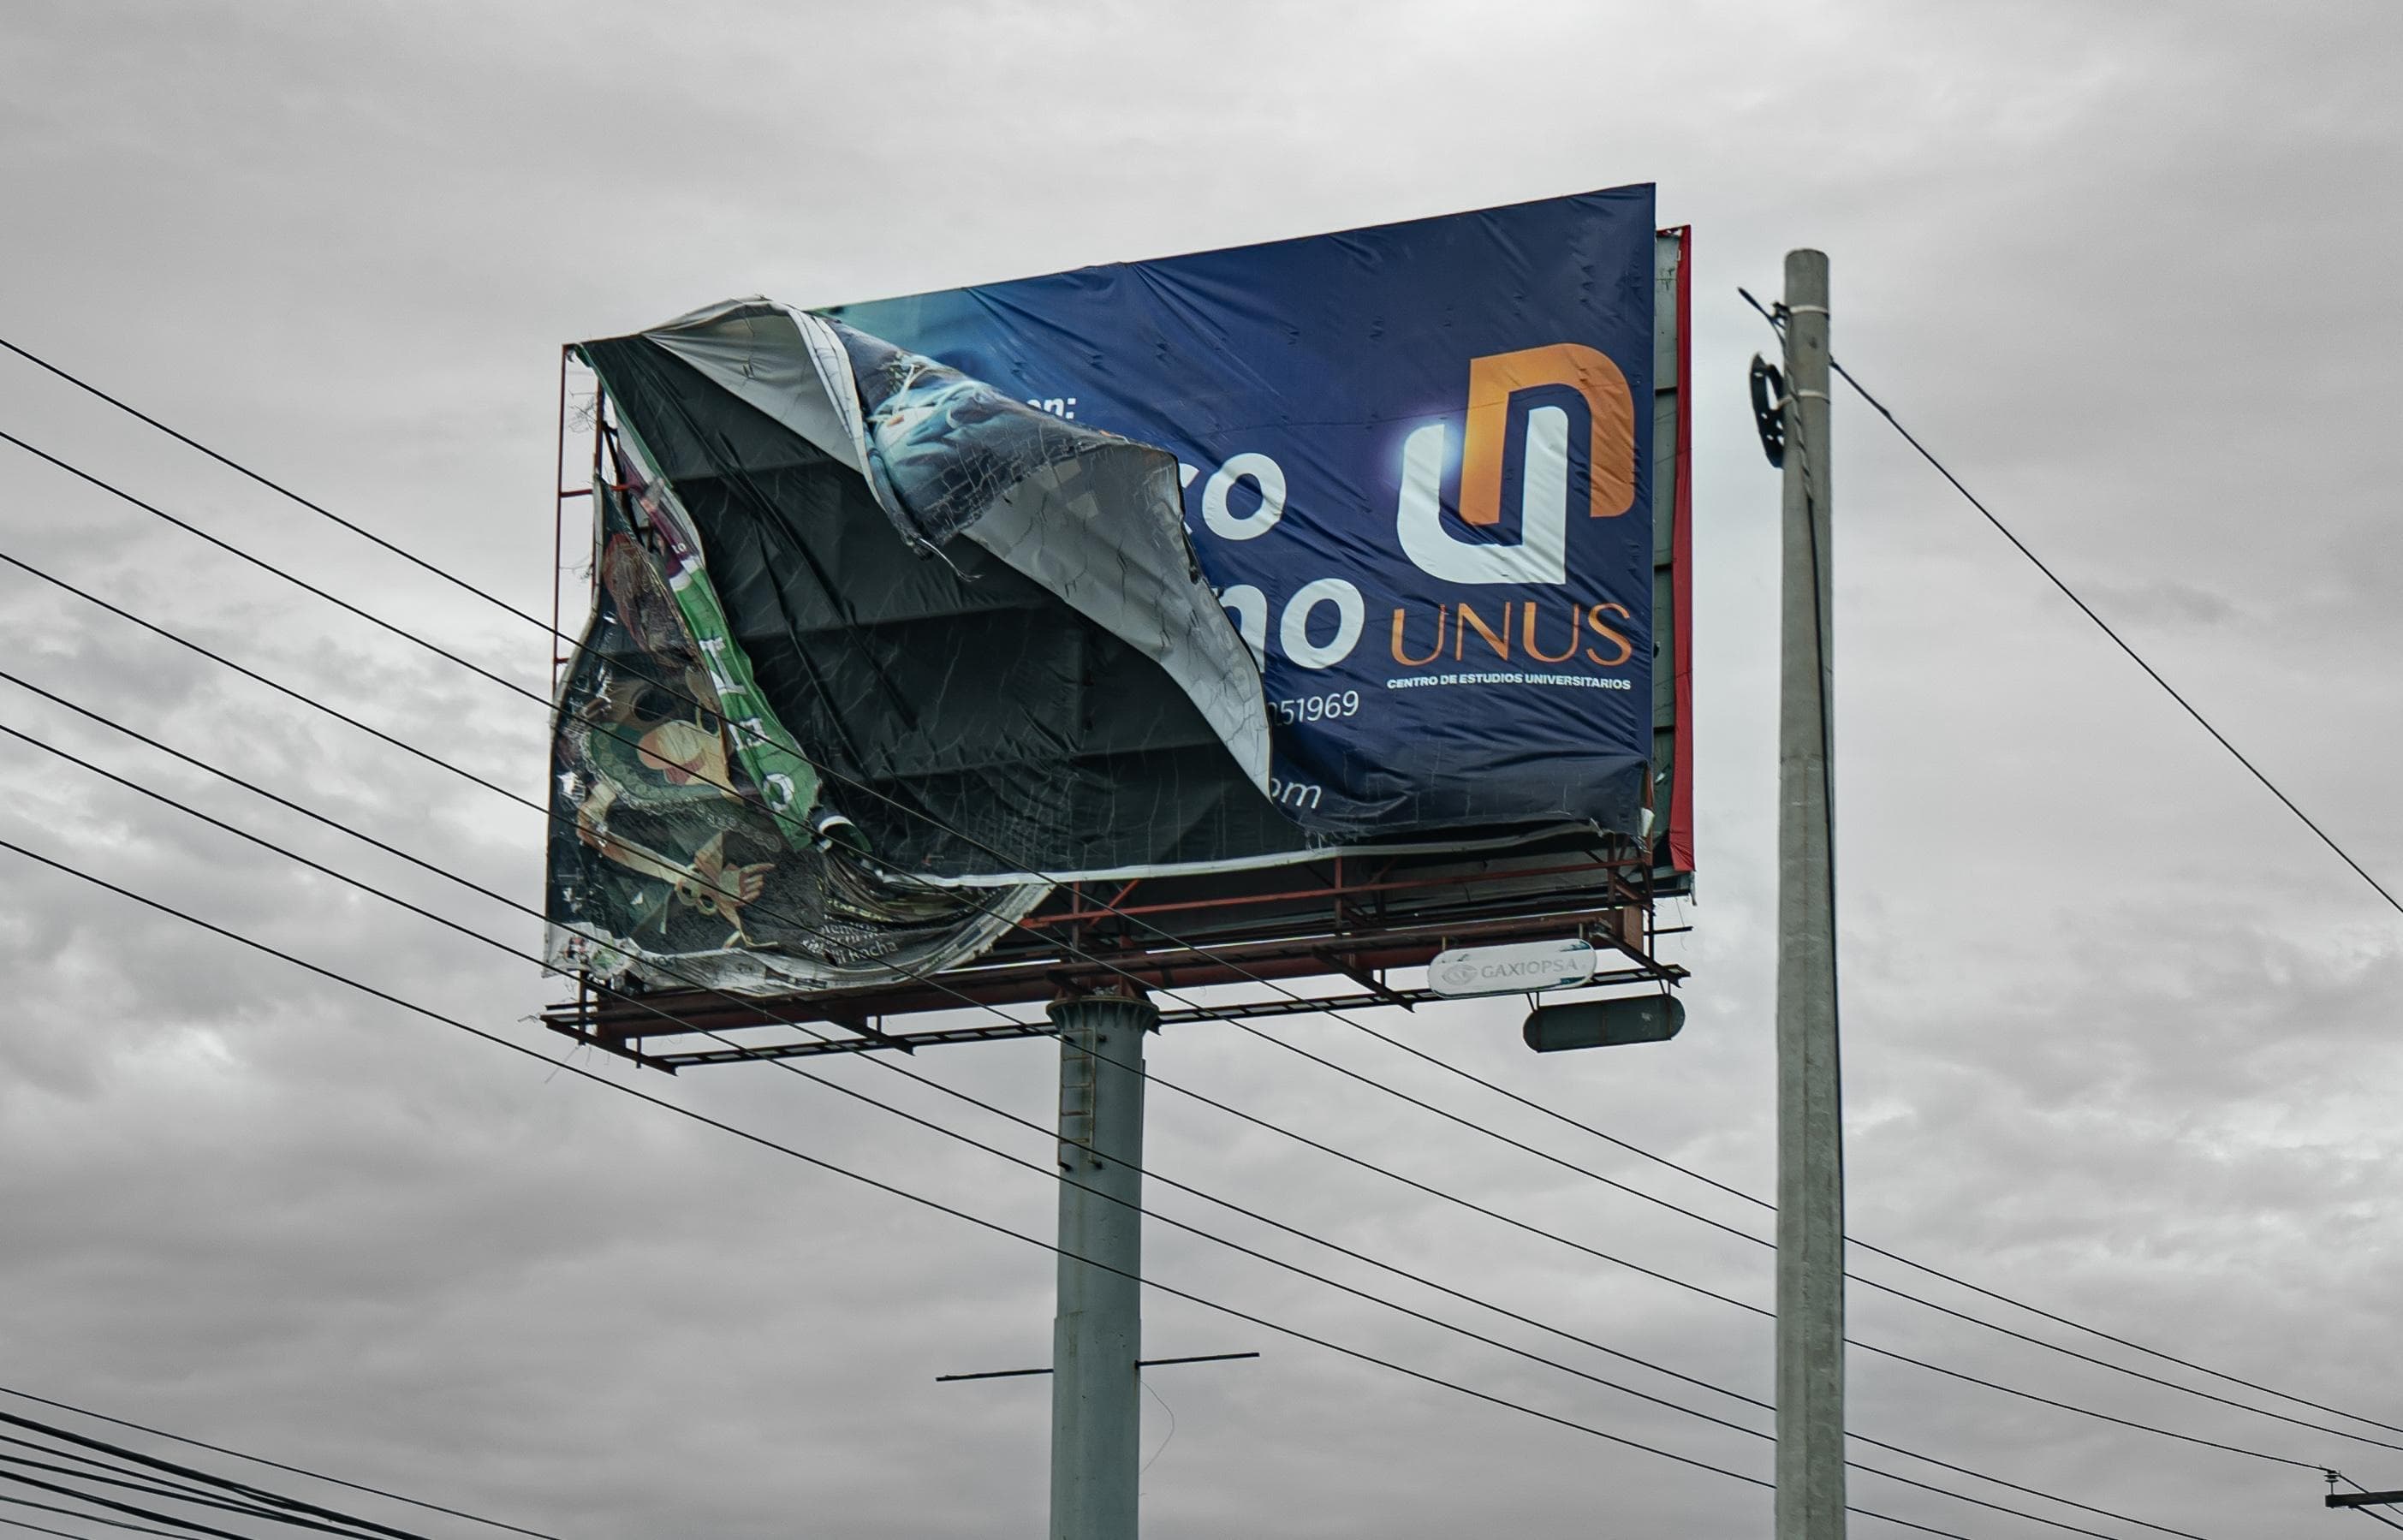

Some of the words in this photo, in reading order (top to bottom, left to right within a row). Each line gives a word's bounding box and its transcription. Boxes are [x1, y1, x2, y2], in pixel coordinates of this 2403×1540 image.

[1391, 601, 1633, 667] UNUS
[1387, 675, 1438, 689] CENTRO
[1440, 674, 1457, 686] DE
[1459, 673, 1523, 685] ESTUDIOS
[1525, 674, 1632, 690] UNIVERSITARIOS
[1481, 958, 1578, 978] GAXIOPSA
